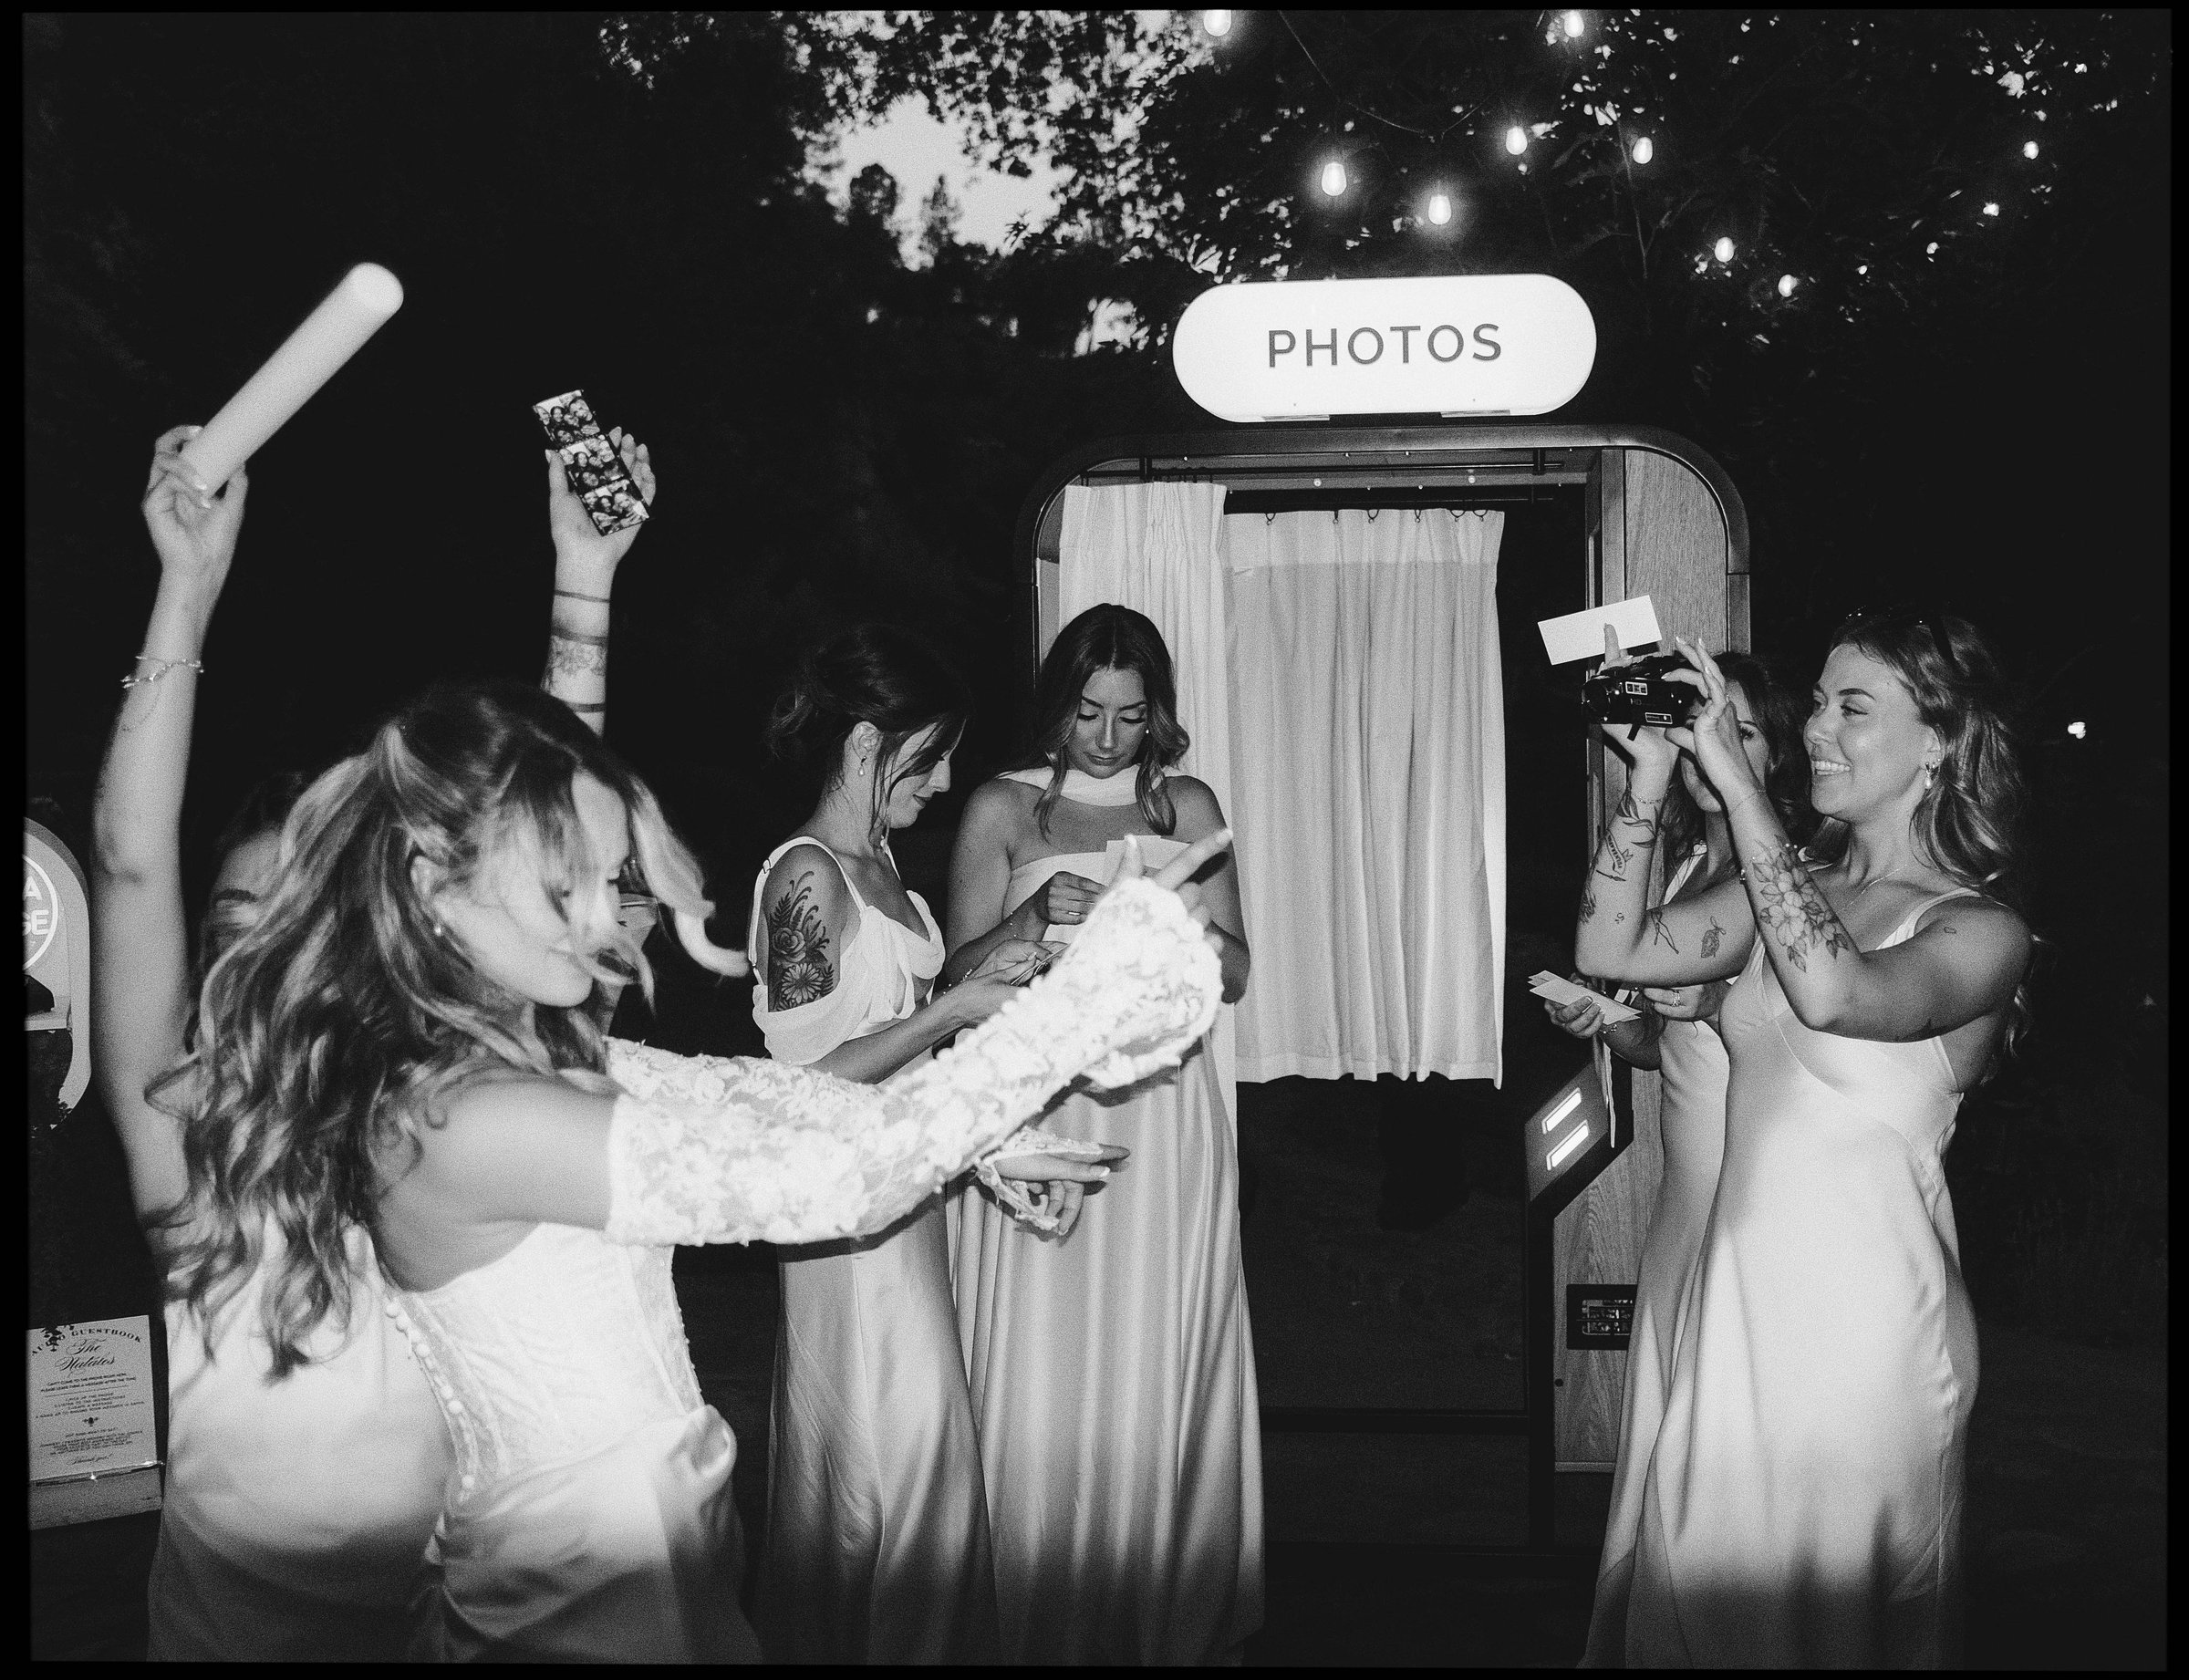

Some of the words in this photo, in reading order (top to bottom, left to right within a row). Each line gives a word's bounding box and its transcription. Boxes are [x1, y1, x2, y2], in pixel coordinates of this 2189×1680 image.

[1267, 323, 1502, 368] PHOTOS
[71, 1327, 141, 1343] GUESTBOOK
[66, 1337, 108, 1356] The
